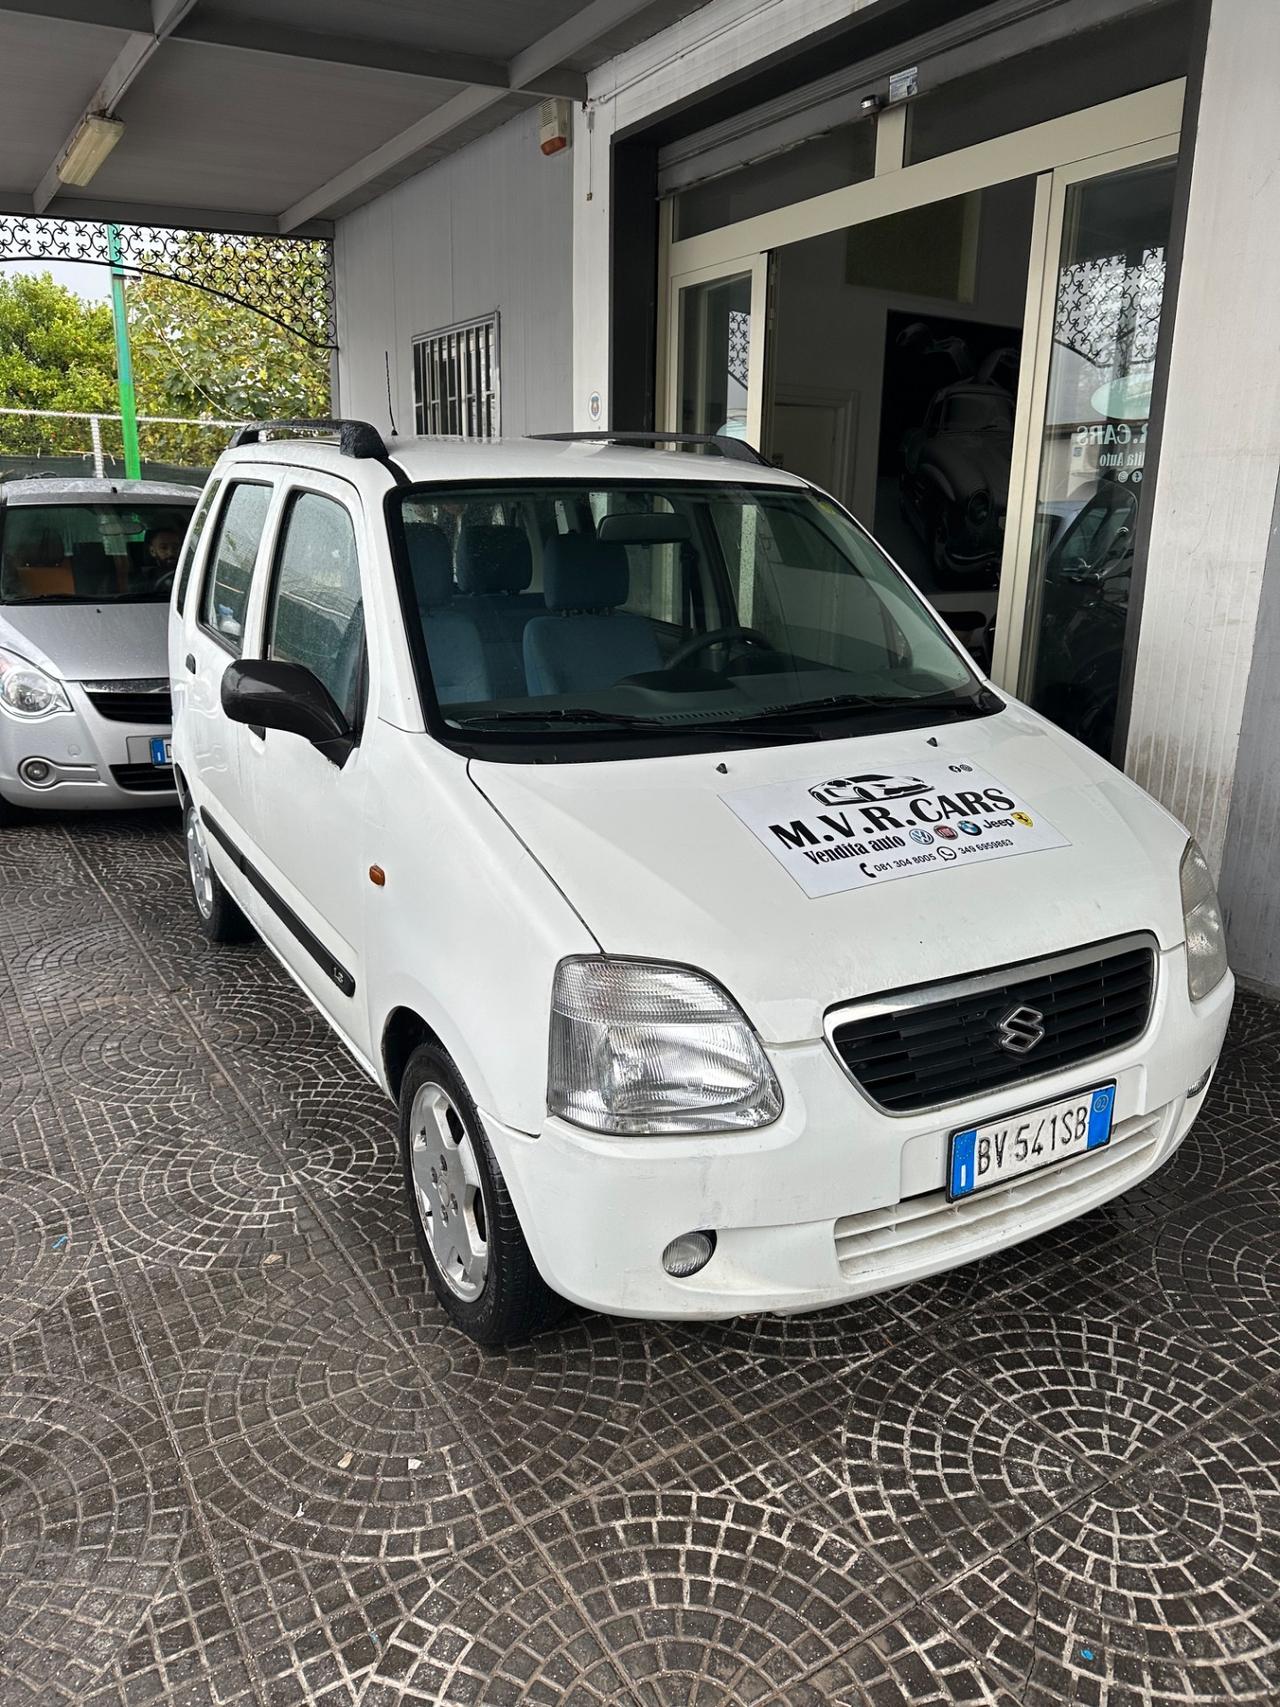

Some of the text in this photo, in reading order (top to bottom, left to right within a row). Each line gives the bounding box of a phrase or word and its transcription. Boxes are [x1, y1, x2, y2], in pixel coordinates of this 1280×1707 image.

[803, 841, 871, 865] Vendita
[868, 835, 906, 852] auto
[983, 818, 1015, 829] Jeep
[958, 845, 977, 854] 349
[873, 853, 937, 872] 081 304 8005
